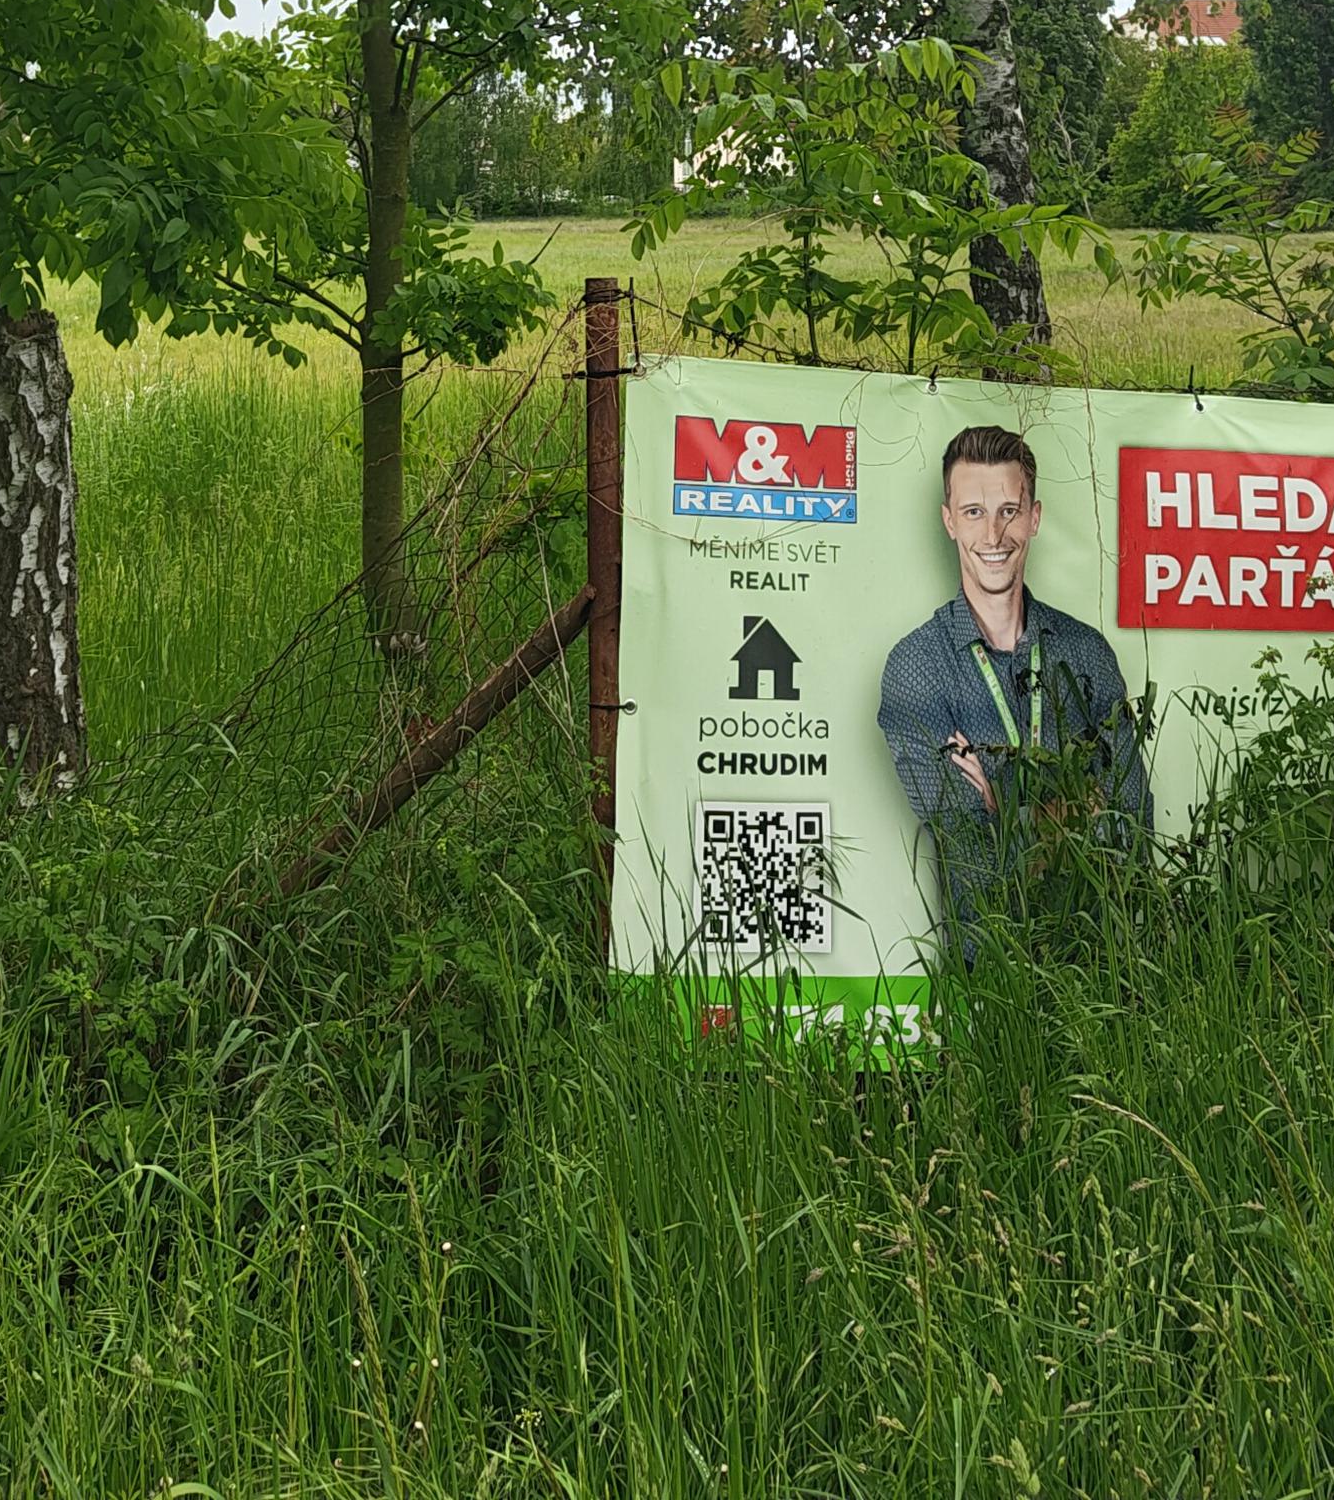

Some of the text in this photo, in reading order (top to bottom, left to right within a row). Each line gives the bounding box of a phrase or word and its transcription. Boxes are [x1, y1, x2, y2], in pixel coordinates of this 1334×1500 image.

[674, 415, 858, 490] M&M
[680, 490, 850, 518] REALITY
[690, 535, 842, 564] MĚNÍME SVĚT
[730, 571, 810, 592] REALIT
[1190, 686, 1258, 725] Nejsi
[1268, 696, 1285, 715] z
[698, 710, 830, 741] pobočka
[697, 750, 828, 776] CHRUDIM
